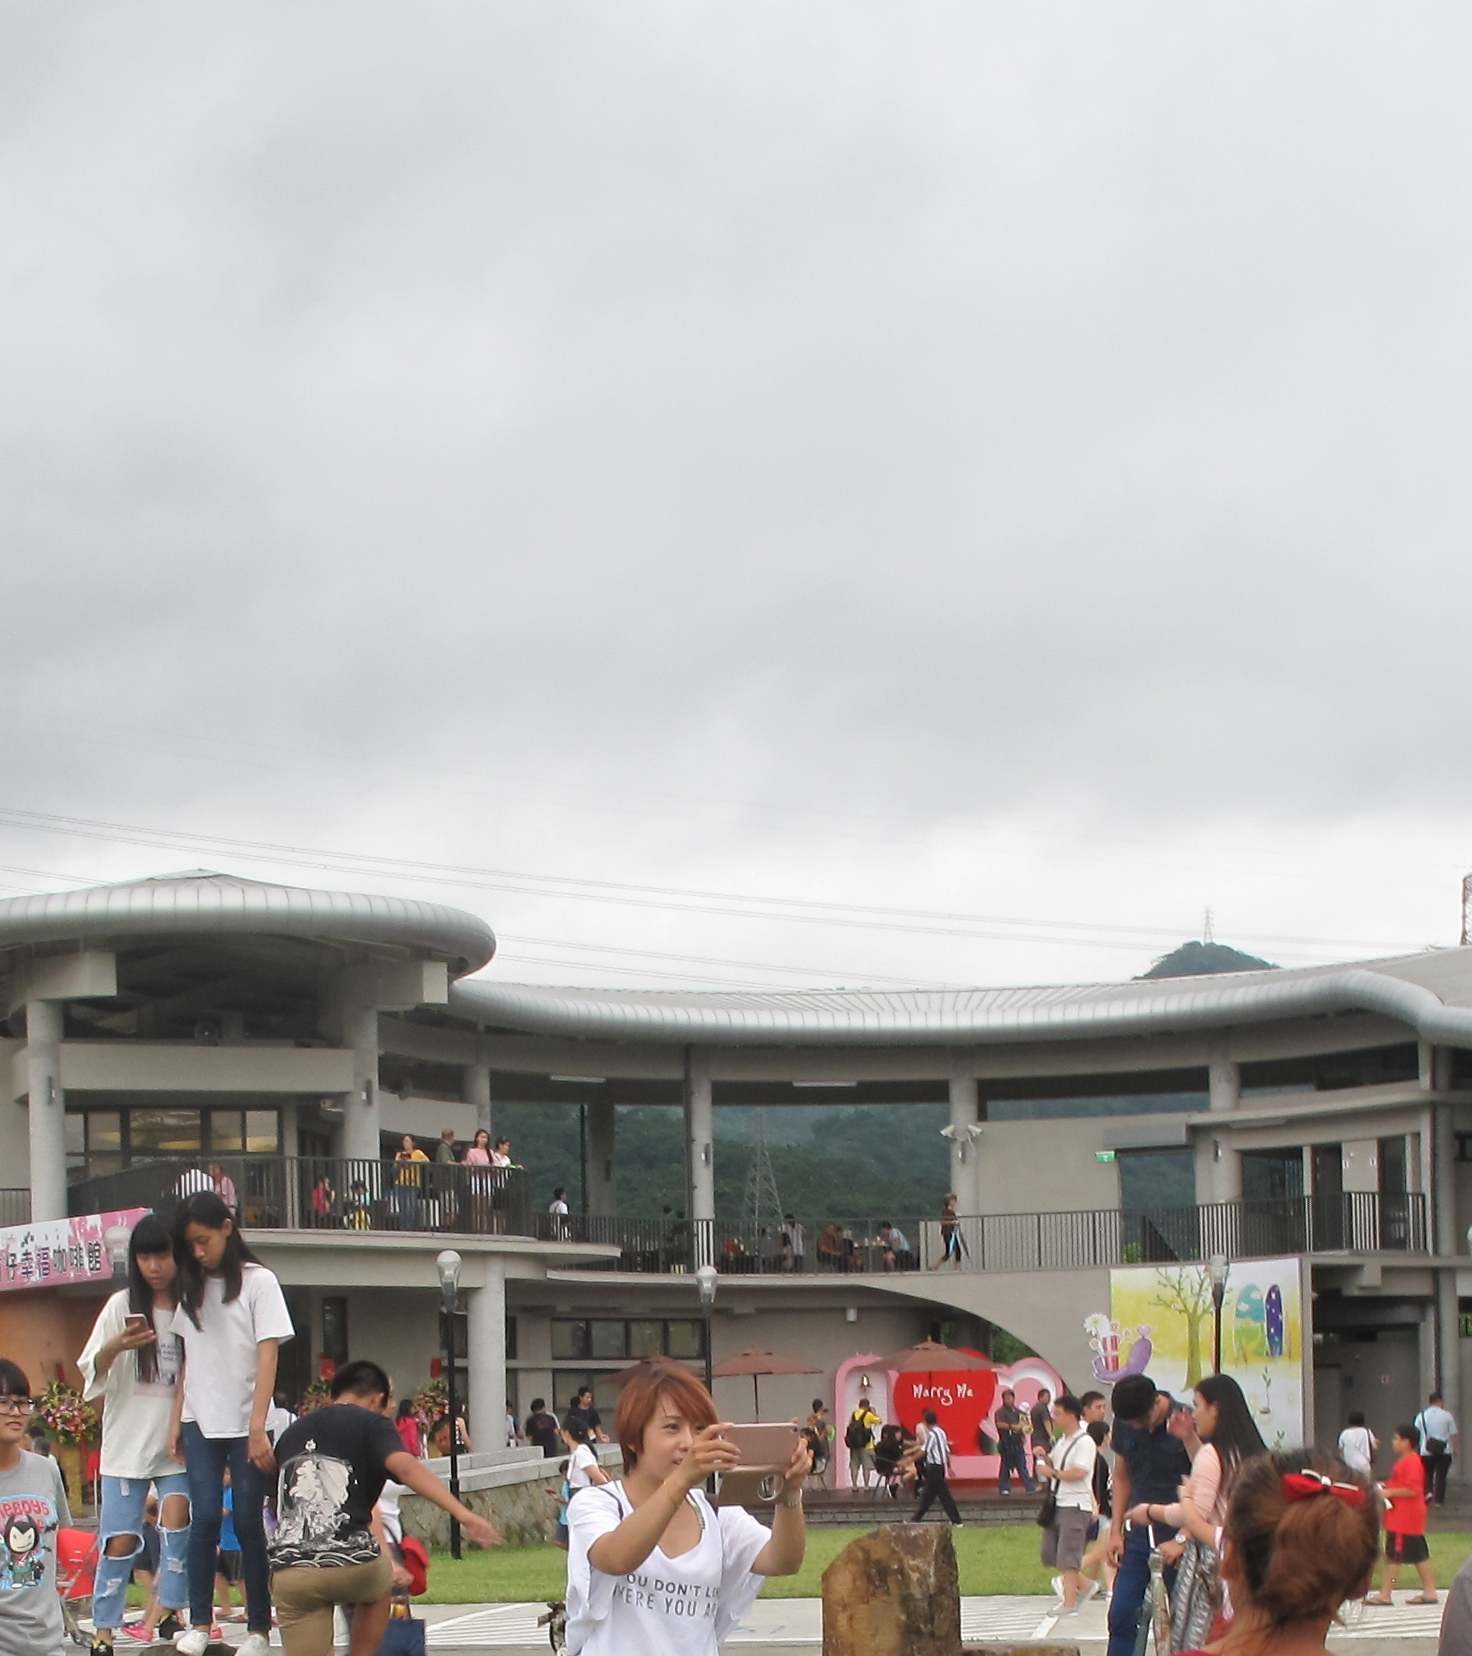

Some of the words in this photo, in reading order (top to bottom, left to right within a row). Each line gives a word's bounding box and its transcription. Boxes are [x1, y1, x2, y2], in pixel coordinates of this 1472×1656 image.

[912, 1383, 954, 1406] Marry
[956, 1383, 974, 1398] Me
[626, 1573, 648, 1588] OU
[654, 1579, 702, 1598] DON'T
[664, 1598, 697, 1617] YOU
